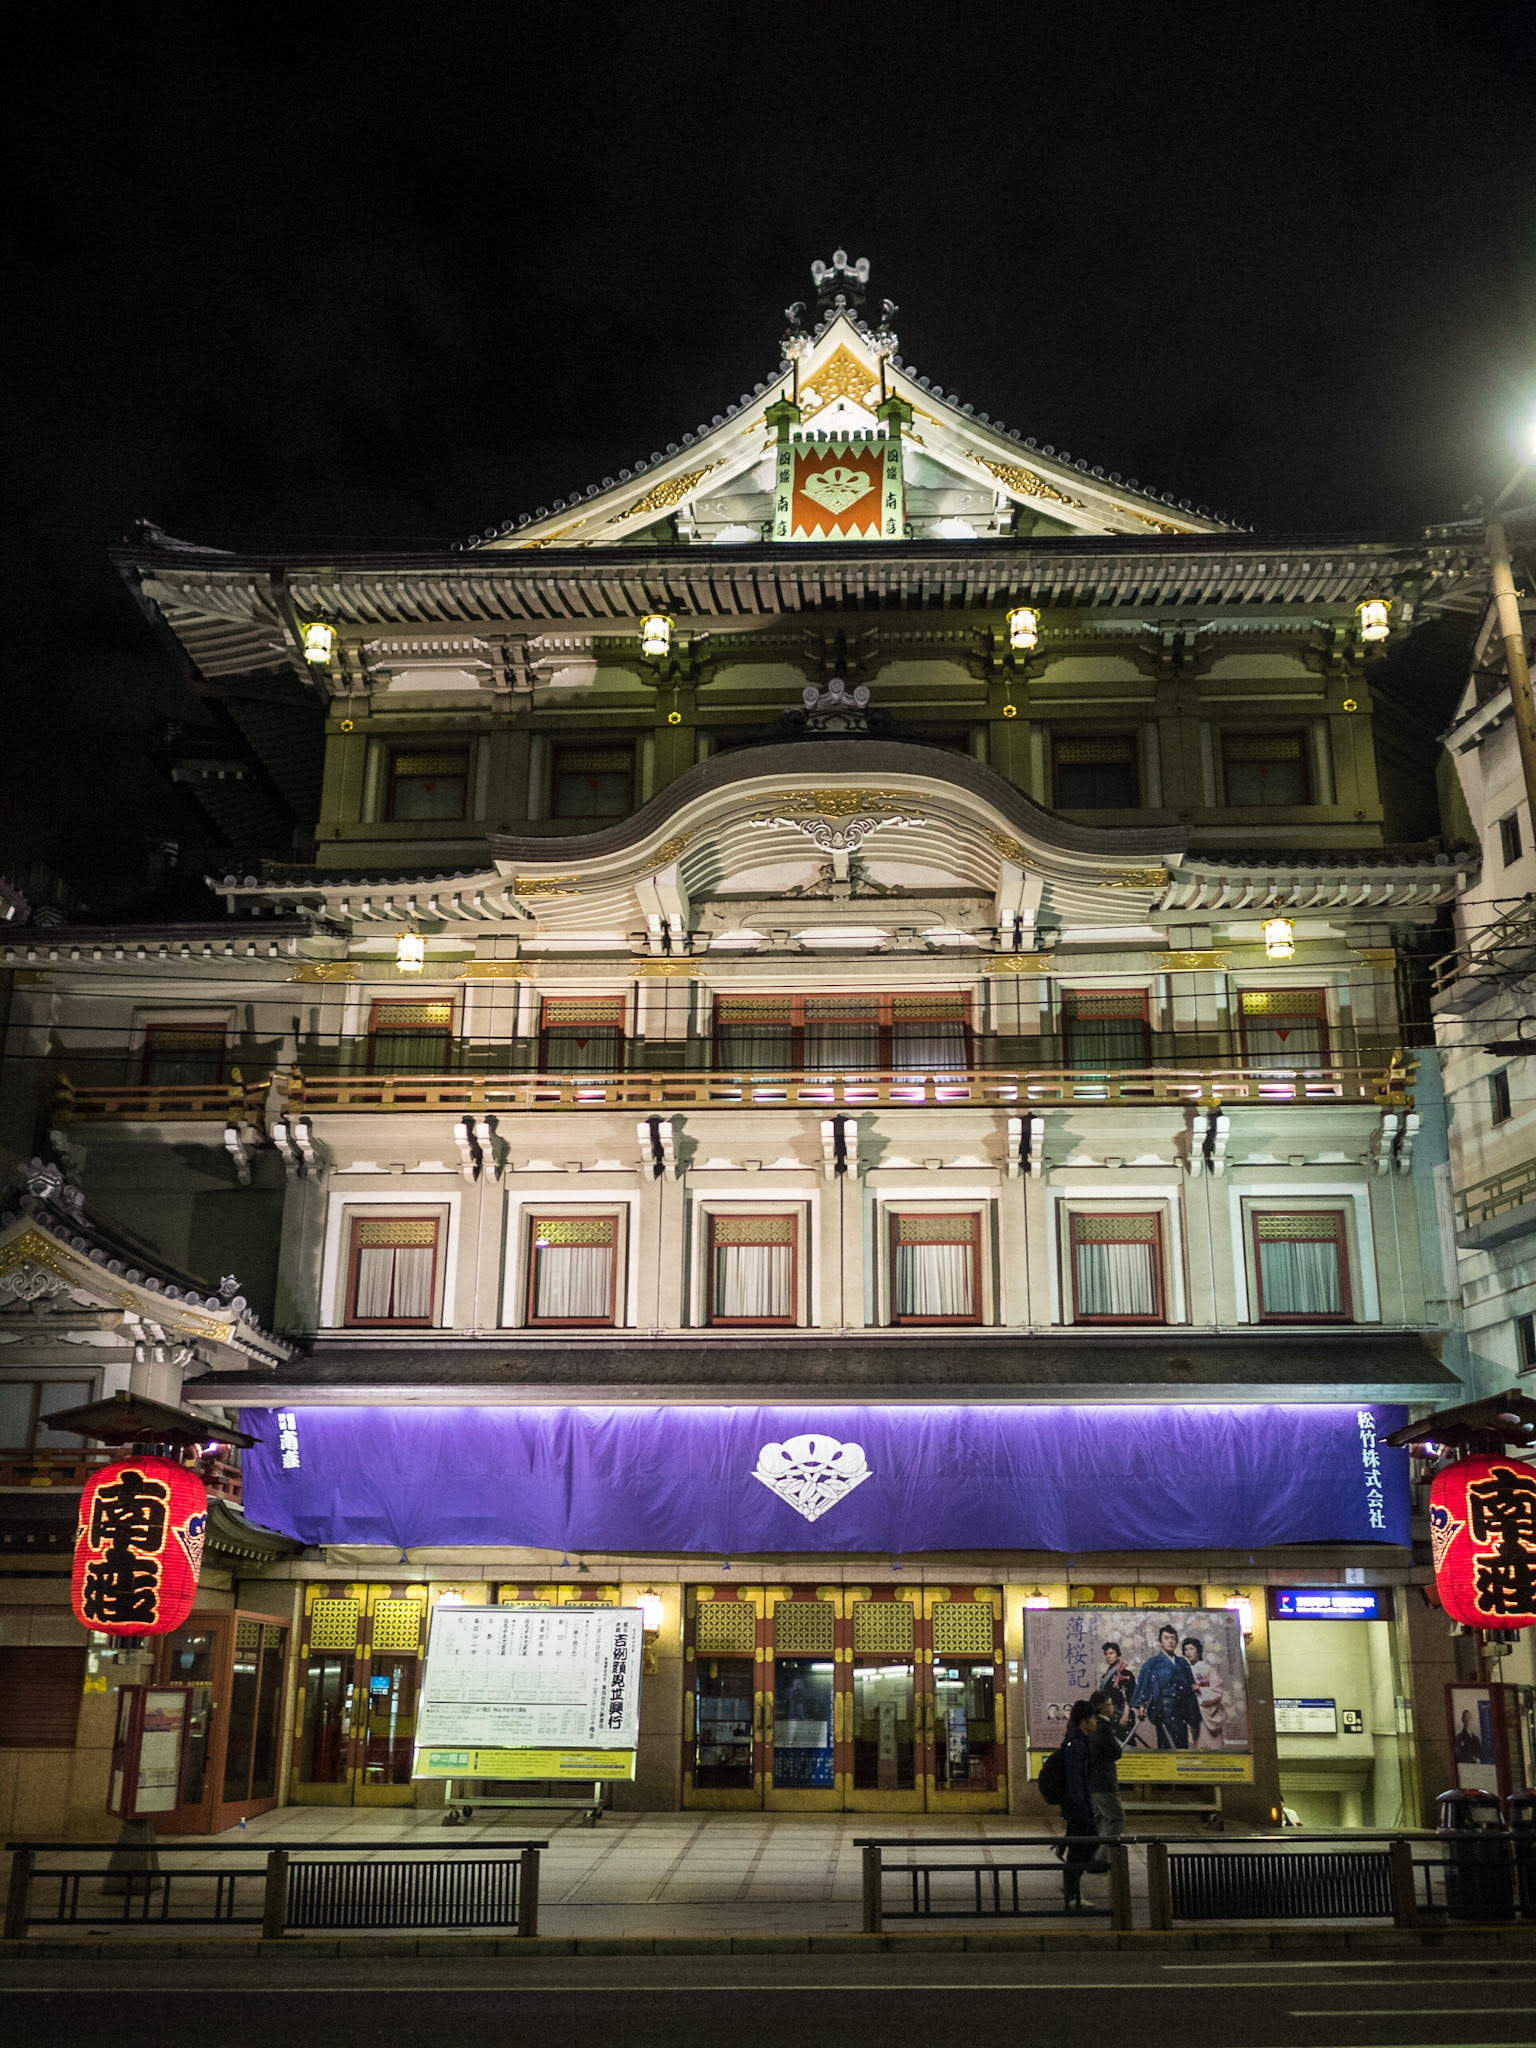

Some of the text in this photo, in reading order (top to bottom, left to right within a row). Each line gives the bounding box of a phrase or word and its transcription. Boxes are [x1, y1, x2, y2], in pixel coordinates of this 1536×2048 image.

[1357, 1410, 1387, 1529] 松竹株式会社
[82, 1470, 171, 1625] 南座
[1065, 1616, 1090, 1689] 薄桜記
[1346, 1713, 1354, 1723] 6
